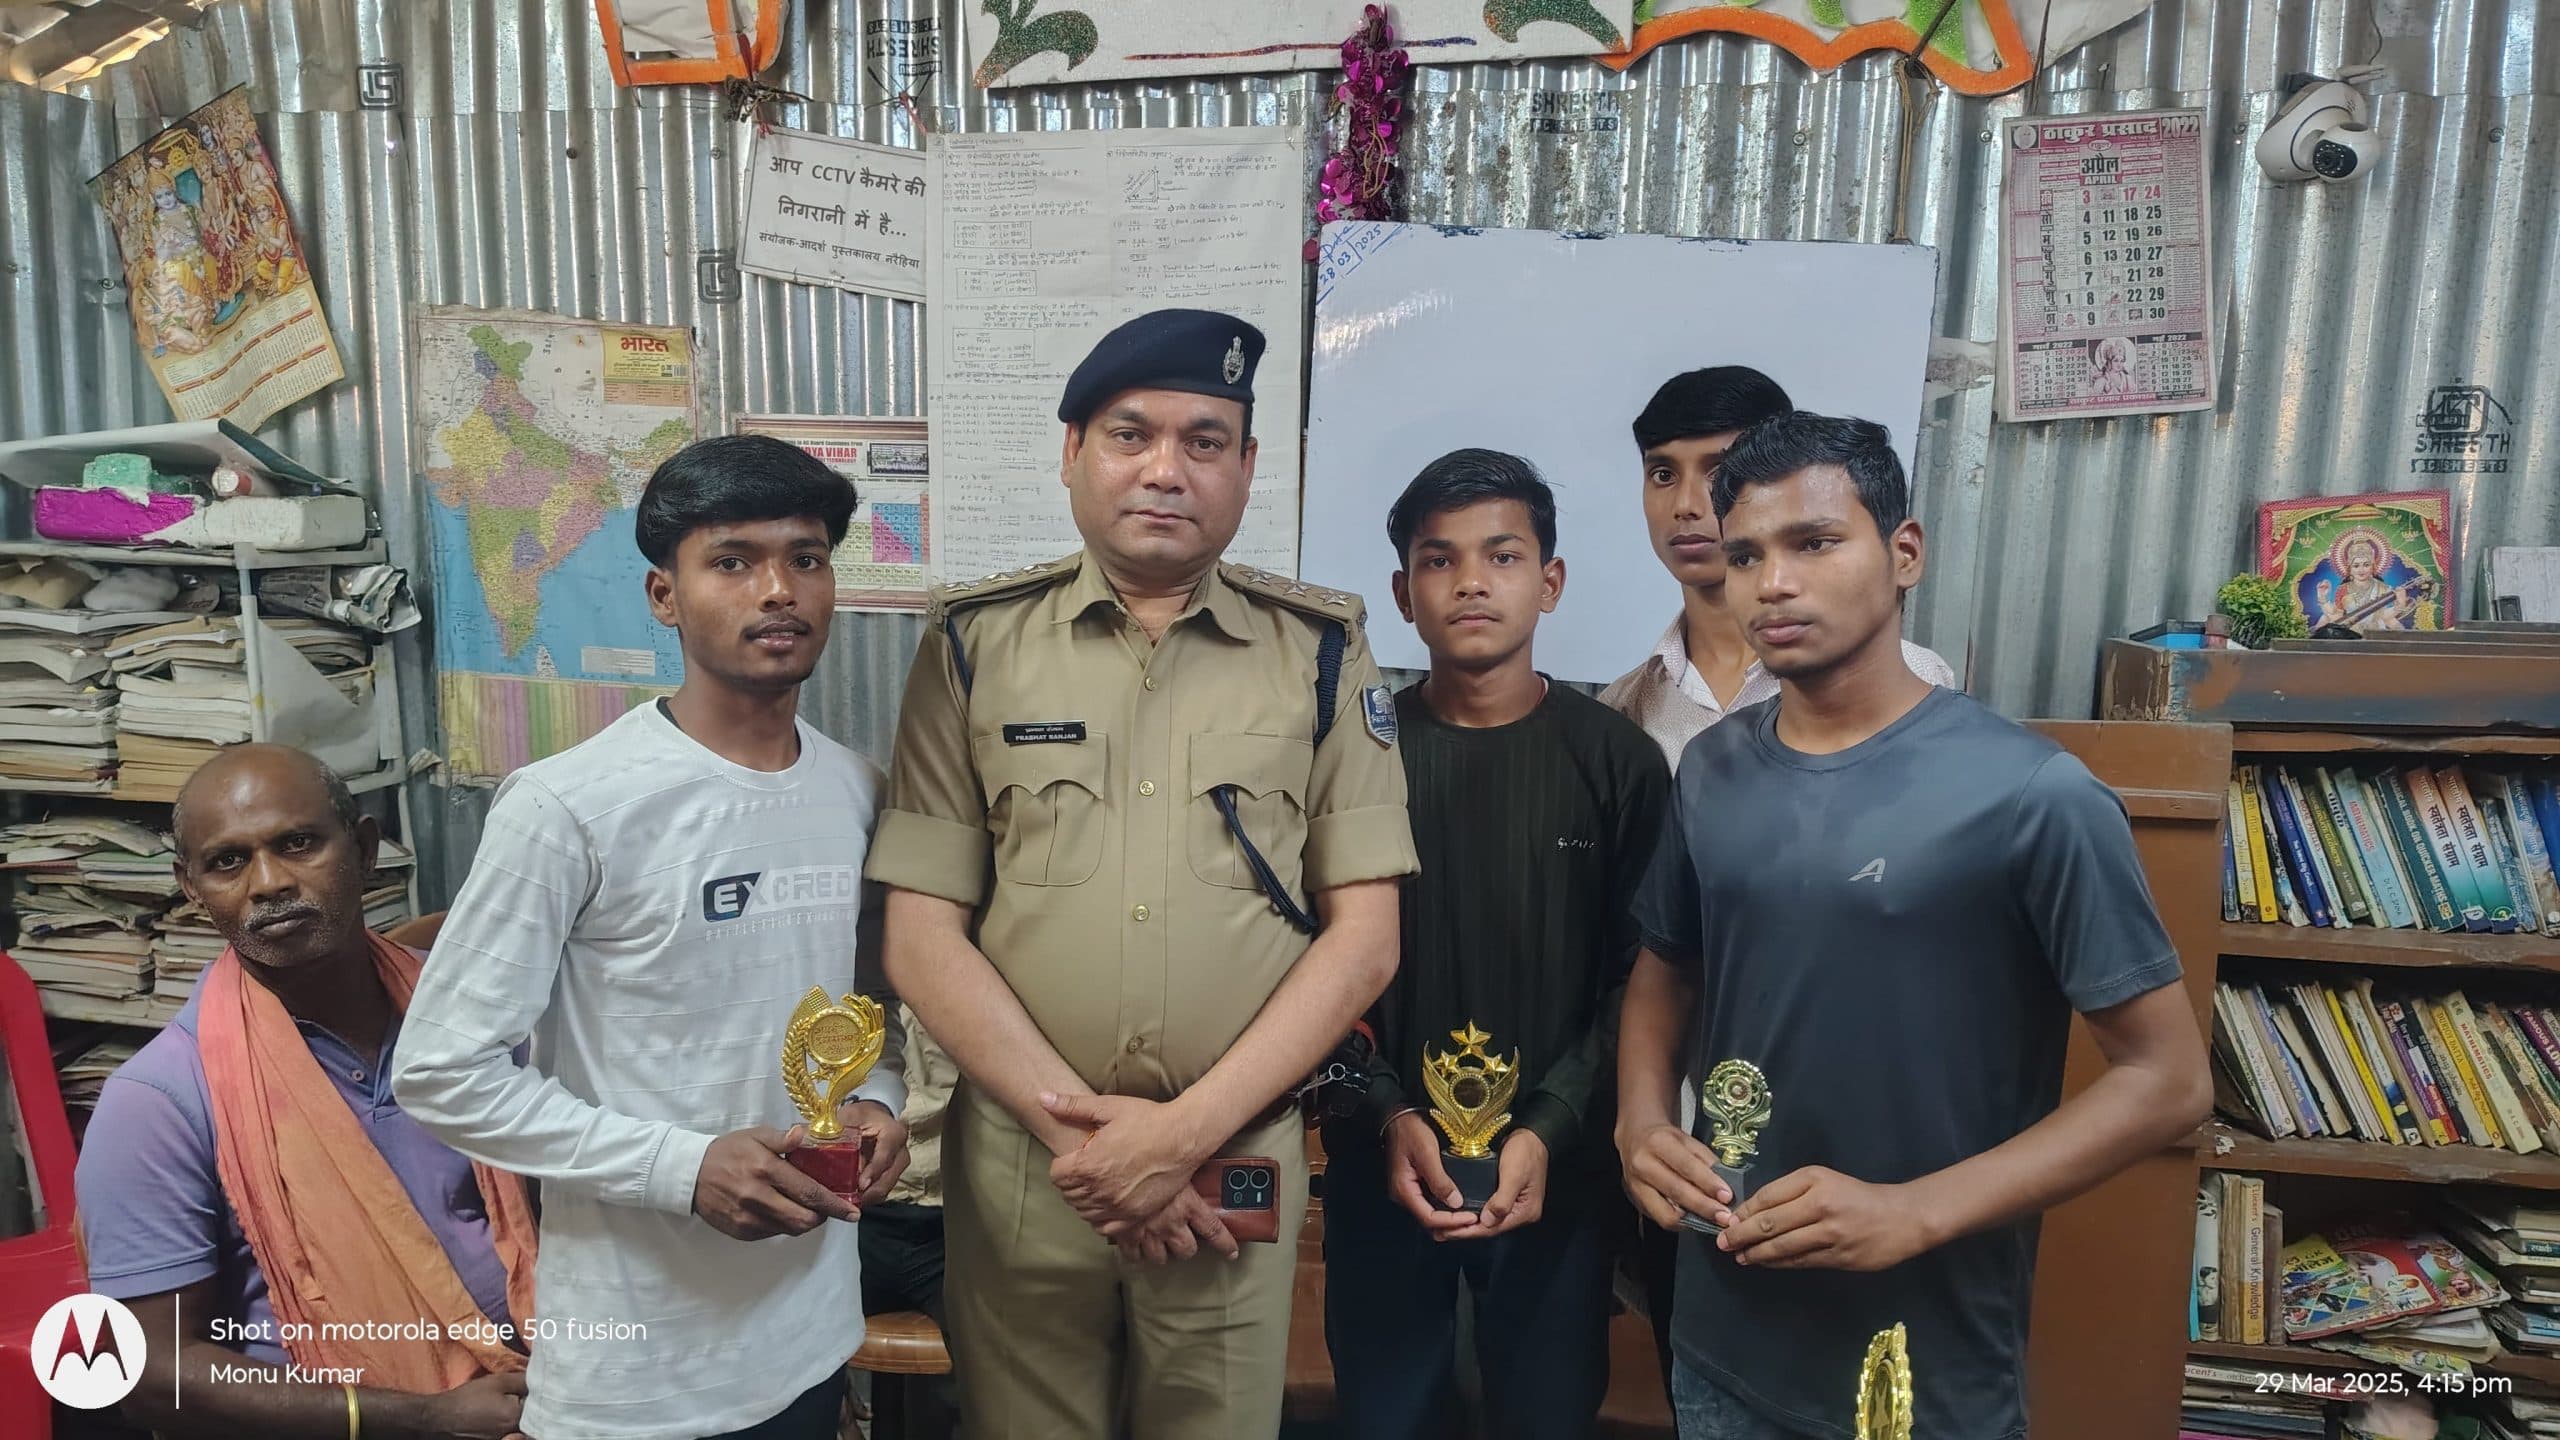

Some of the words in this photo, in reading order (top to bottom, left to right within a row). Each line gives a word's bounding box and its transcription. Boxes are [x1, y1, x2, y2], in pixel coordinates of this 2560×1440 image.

[2161, 117, 2199, 139] 2022
[2081, 152, 2119, 175] अप्रैल
[771, 155, 803, 176] आप
[812, 164, 856, 185] CCTV
[859, 166, 900, 194] कैमरे
[904, 176, 926, 198] की
[2084, 175, 2117, 185] APRIL
[2082, 190, 2091, 204] 3
[2123, 188, 2136, 201] 17
[2145, 185, 2161, 199] 24
[778, 195, 846, 226] निगरानी
[854, 209, 870, 230] में
[2083, 211, 2090, 224] 4
[2103, 209, 2115, 223] 11
[2124, 207, 2138, 221] 18
[2146, 206, 2161, 219] 25
[2083, 231, 2091, 245] 5
[2103, 229, 2116, 241] 12
[2125, 228, 2140, 241] 19
[2147, 225, 2162, 237] 26
[831, 243, 881, 262] पुस्तकालय
[2084, 252, 2092, 265] 6
[2103, 250, 2117, 261] 13
[2126, 248, 2141, 261] 20
[2148, 246, 2163, 260] 27
[2085, 272, 2093, 285] 7
[2127, 268, 2141, 282] 21
[2149, 267, 2164, 277] 28
[2065, 293, 2071, 304] 1
[2086, 291, 2094, 305] 8
[2127, 289, 2142, 302] 22
[2149, 287, 2165, 301] 29
[2087, 312, 2095, 325] 9
[2150, 307, 2165, 319] 30
[620, 336, 669, 353] भारत
[826, 448, 857, 458] VIHAR
[2350, 801, 2376, 852] MATHEMATICS
[2402, 809, 2417, 830] BOOK
[2410, 830, 2422, 843] ON
[2427, 804, 2448, 840] स्वतंत्रता
[2441, 841, 2461, 868] संग्राम
[2456, 804, 2478, 840] स्वतंत्रता
[2470, 841, 2489, 868] संग्राम
[2415, 842, 2436, 875] QUICKER
[2429, 874, 2447, 902] MATHS
[2524, 1010, 2549, 1047] FAMOUS
[2460, 1022, 2492, 1081] MATHEMATICS
[2250, 1227, 2261, 1265] General
[2248, 1268, 2261, 1320] Knowledge
[2184, 1366, 2217, 1378] ucent's
